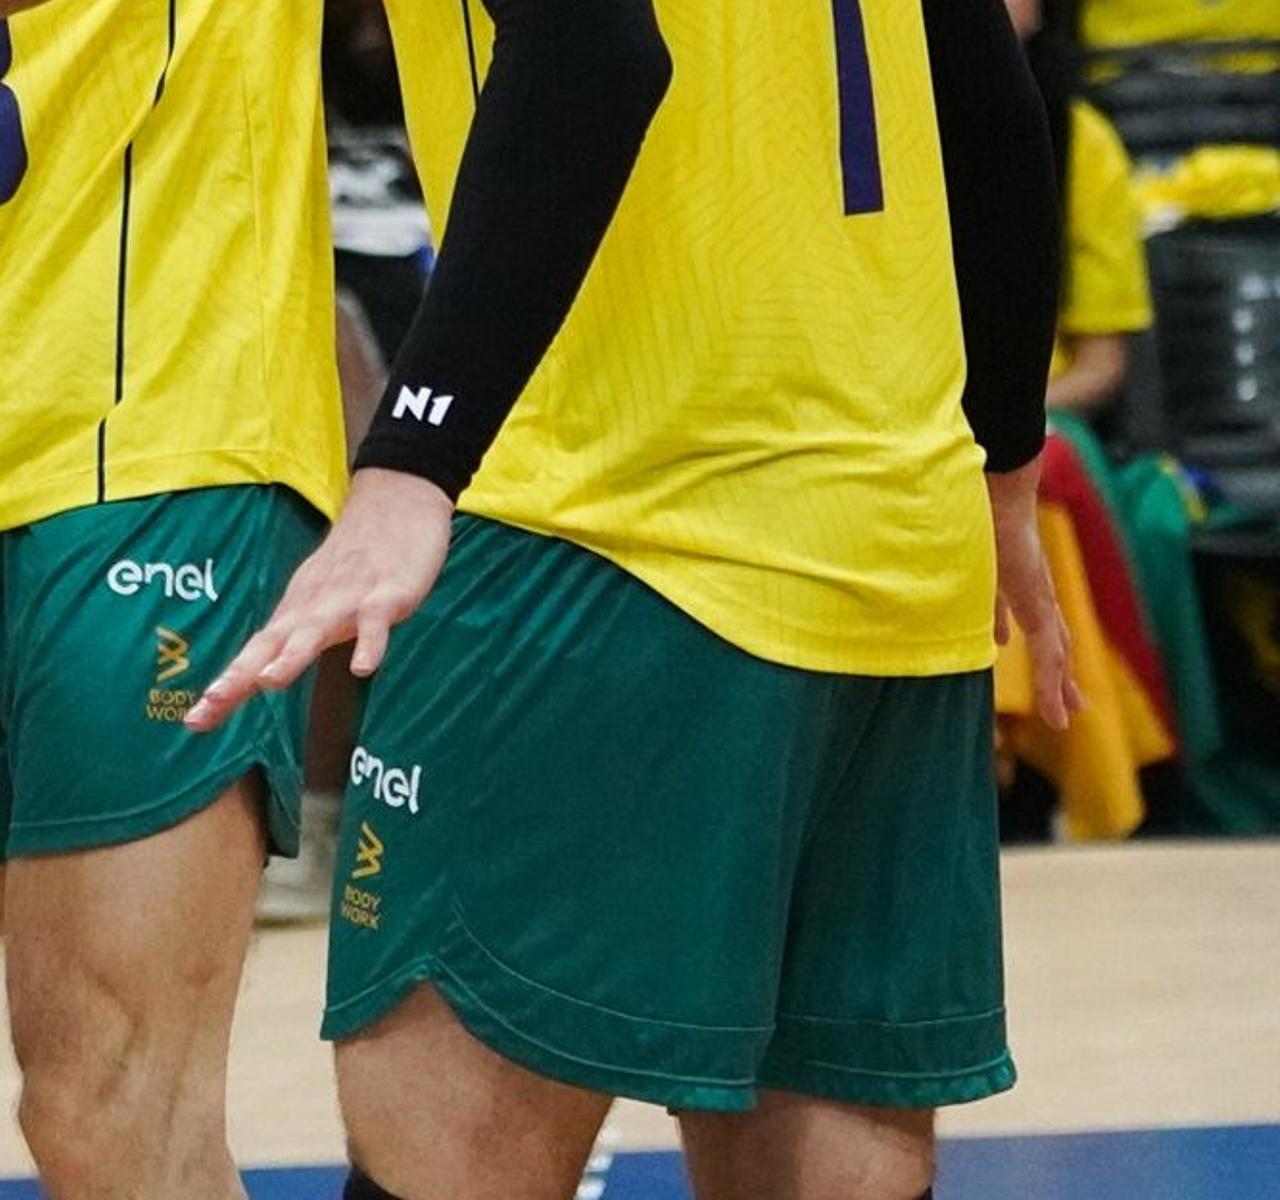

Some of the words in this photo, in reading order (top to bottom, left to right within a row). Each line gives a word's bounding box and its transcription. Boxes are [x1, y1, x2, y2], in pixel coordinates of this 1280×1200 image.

[391, 384, 454, 427] N1
[107, 557, 219, 602] enel
[350, 746, 422, 815] enel
